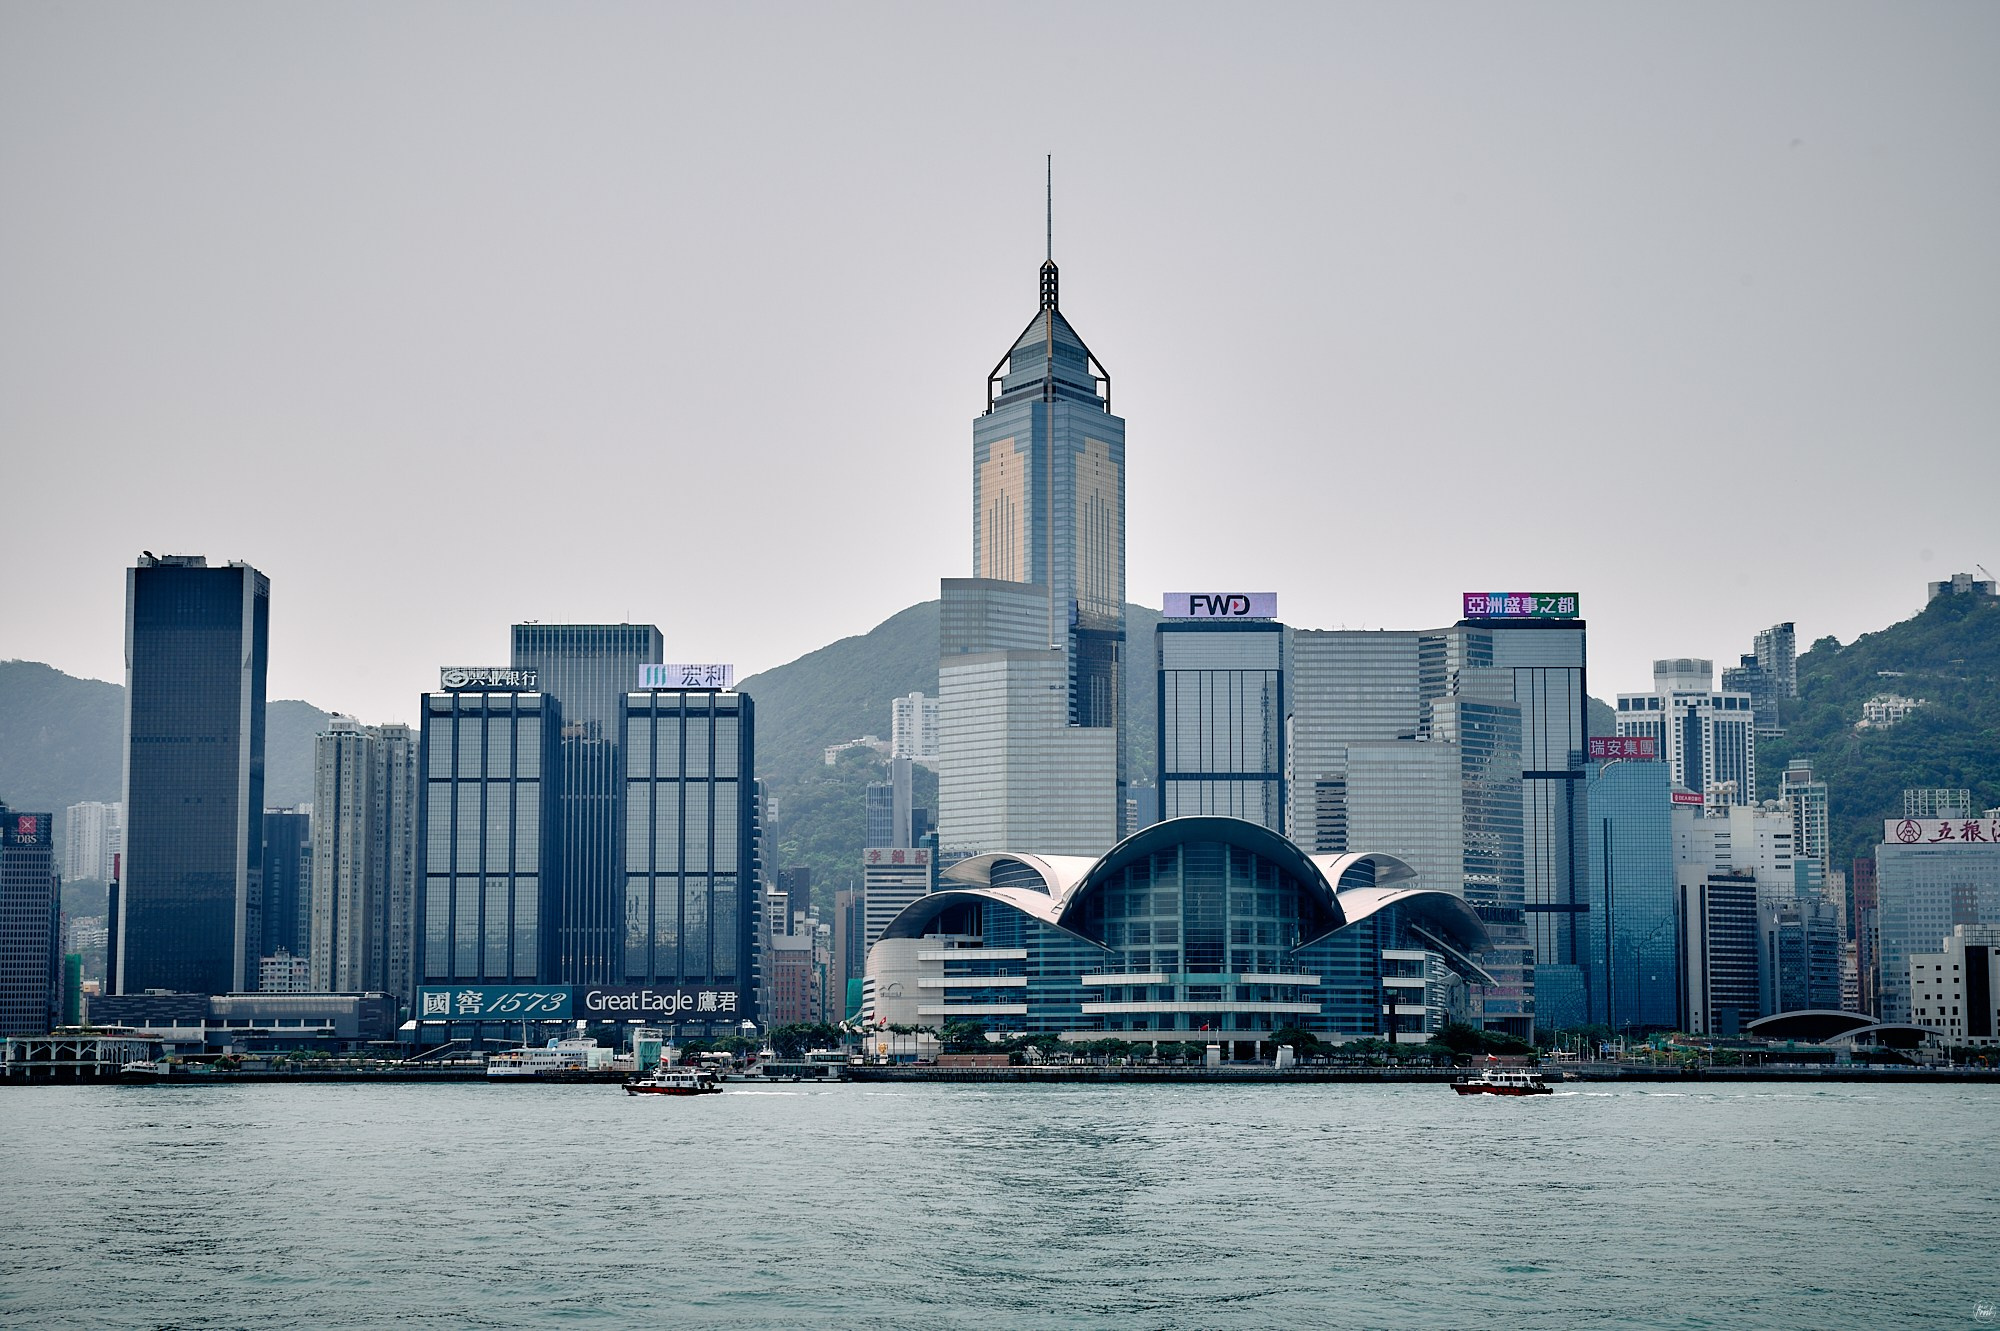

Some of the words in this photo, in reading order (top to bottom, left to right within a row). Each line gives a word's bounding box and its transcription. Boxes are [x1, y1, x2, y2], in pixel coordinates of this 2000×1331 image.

[1190, 595, 1250, 615] FWD
[1467, 597, 1575, 613] 亞洲盛事之都
[469, 670, 537, 686] 兴业银行
[681, 664, 725, 686] 宏利
[1590, 740, 1654, 755] 瑞安集團
[17, 835, 37, 844] DBS
[867, 849, 929, 864] 李錦記
[586, 990, 638, 1010] Great
[641, 989, 694, 1015] Eagle
[696, 991, 738, 1012] 鷹君
